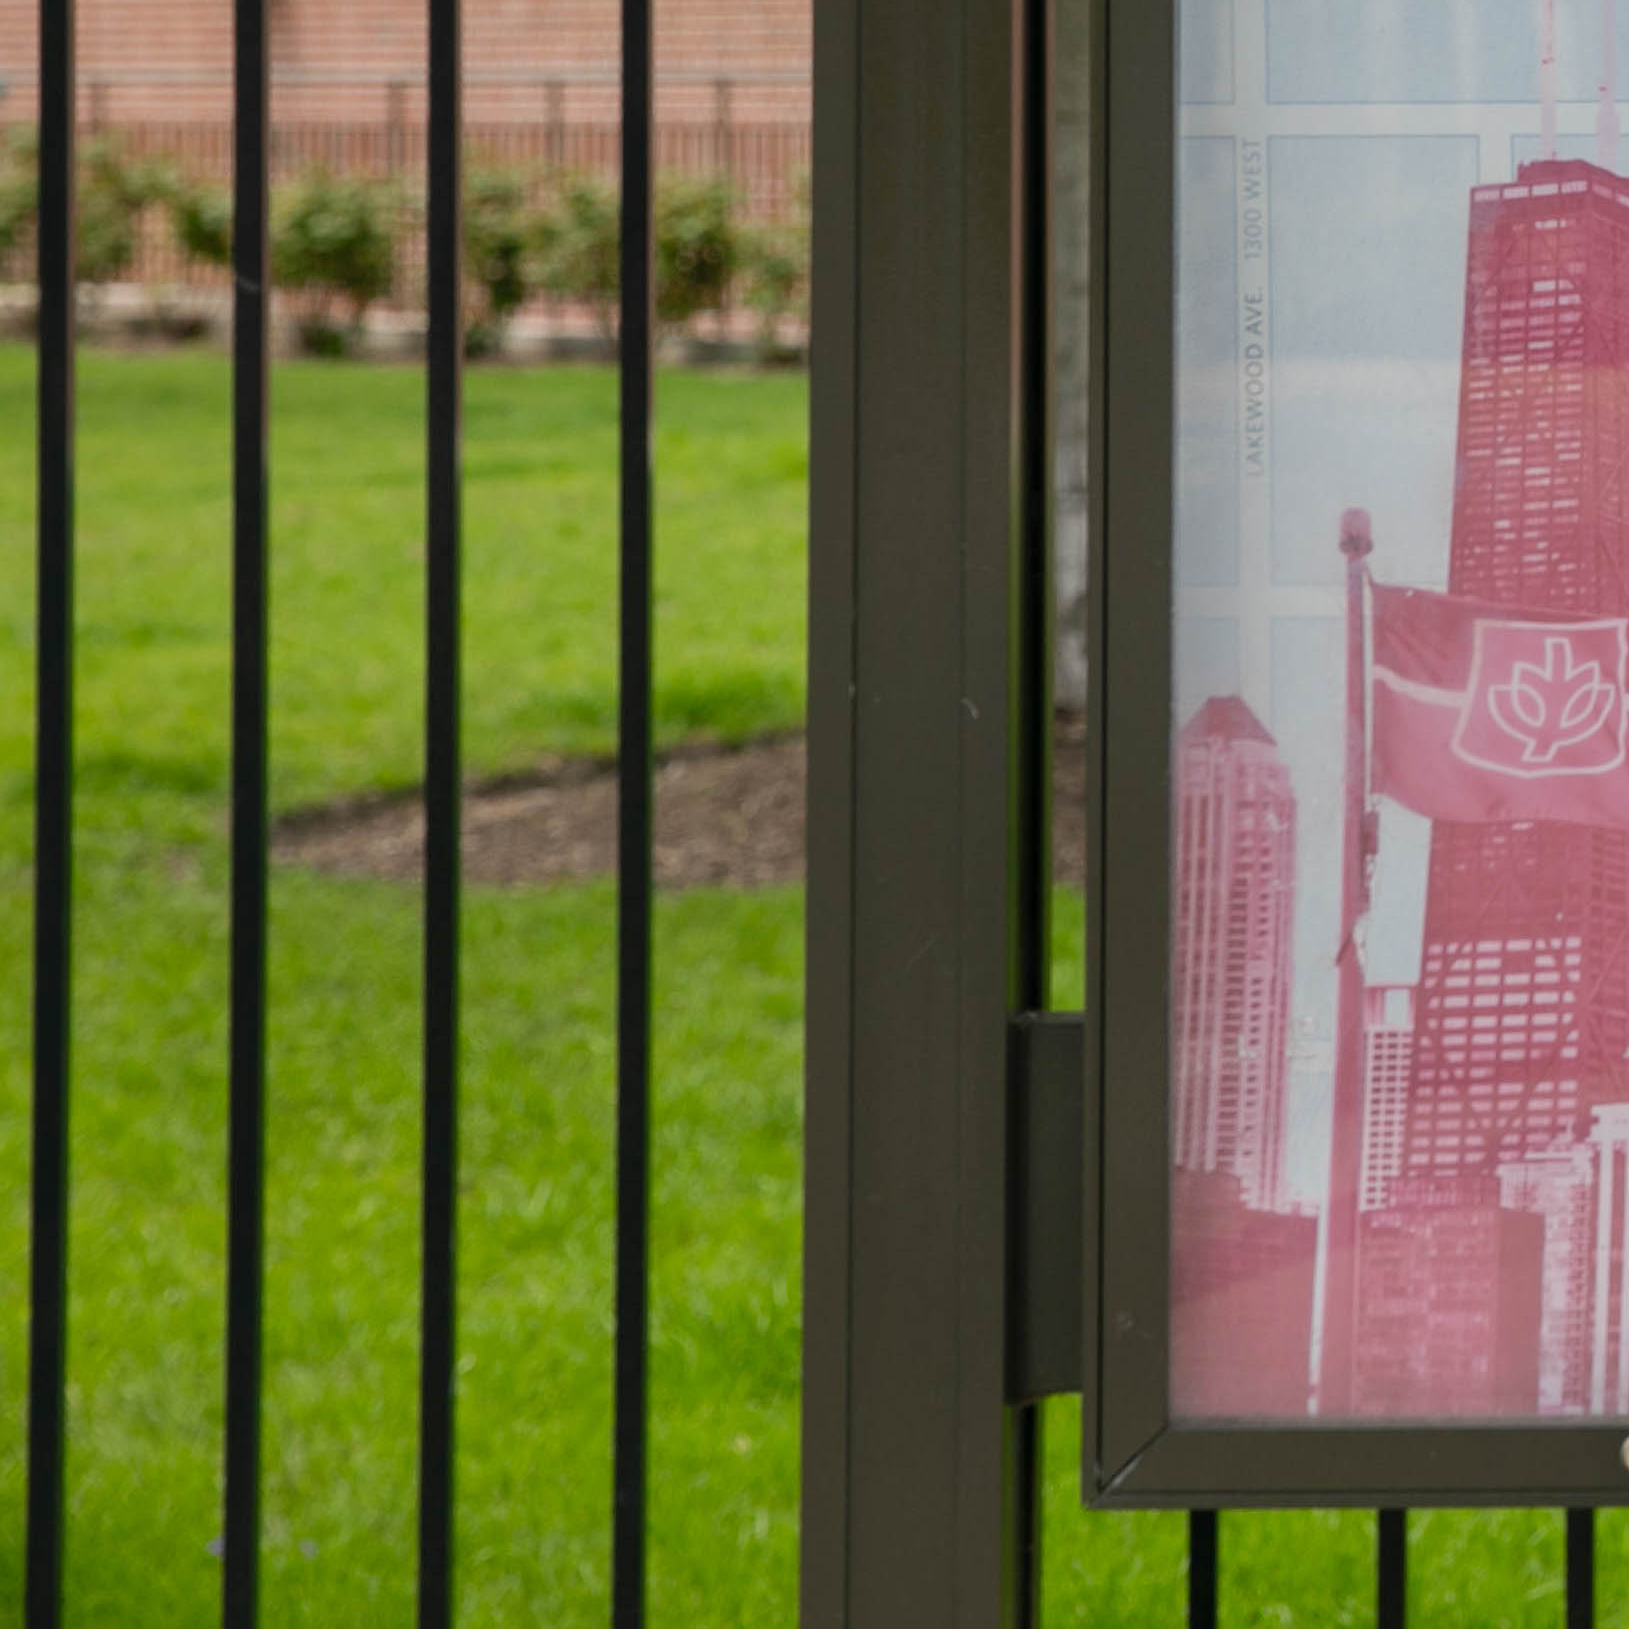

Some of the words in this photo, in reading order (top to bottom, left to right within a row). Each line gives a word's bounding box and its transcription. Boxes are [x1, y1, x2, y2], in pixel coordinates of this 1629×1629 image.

[1242, 140, 1262, 200] WEST
[1243, 209, 1263, 261] 1300
[1244, 286, 1264, 335] AVE.
[1245, 343, 1265, 477] LAKEWOOD
